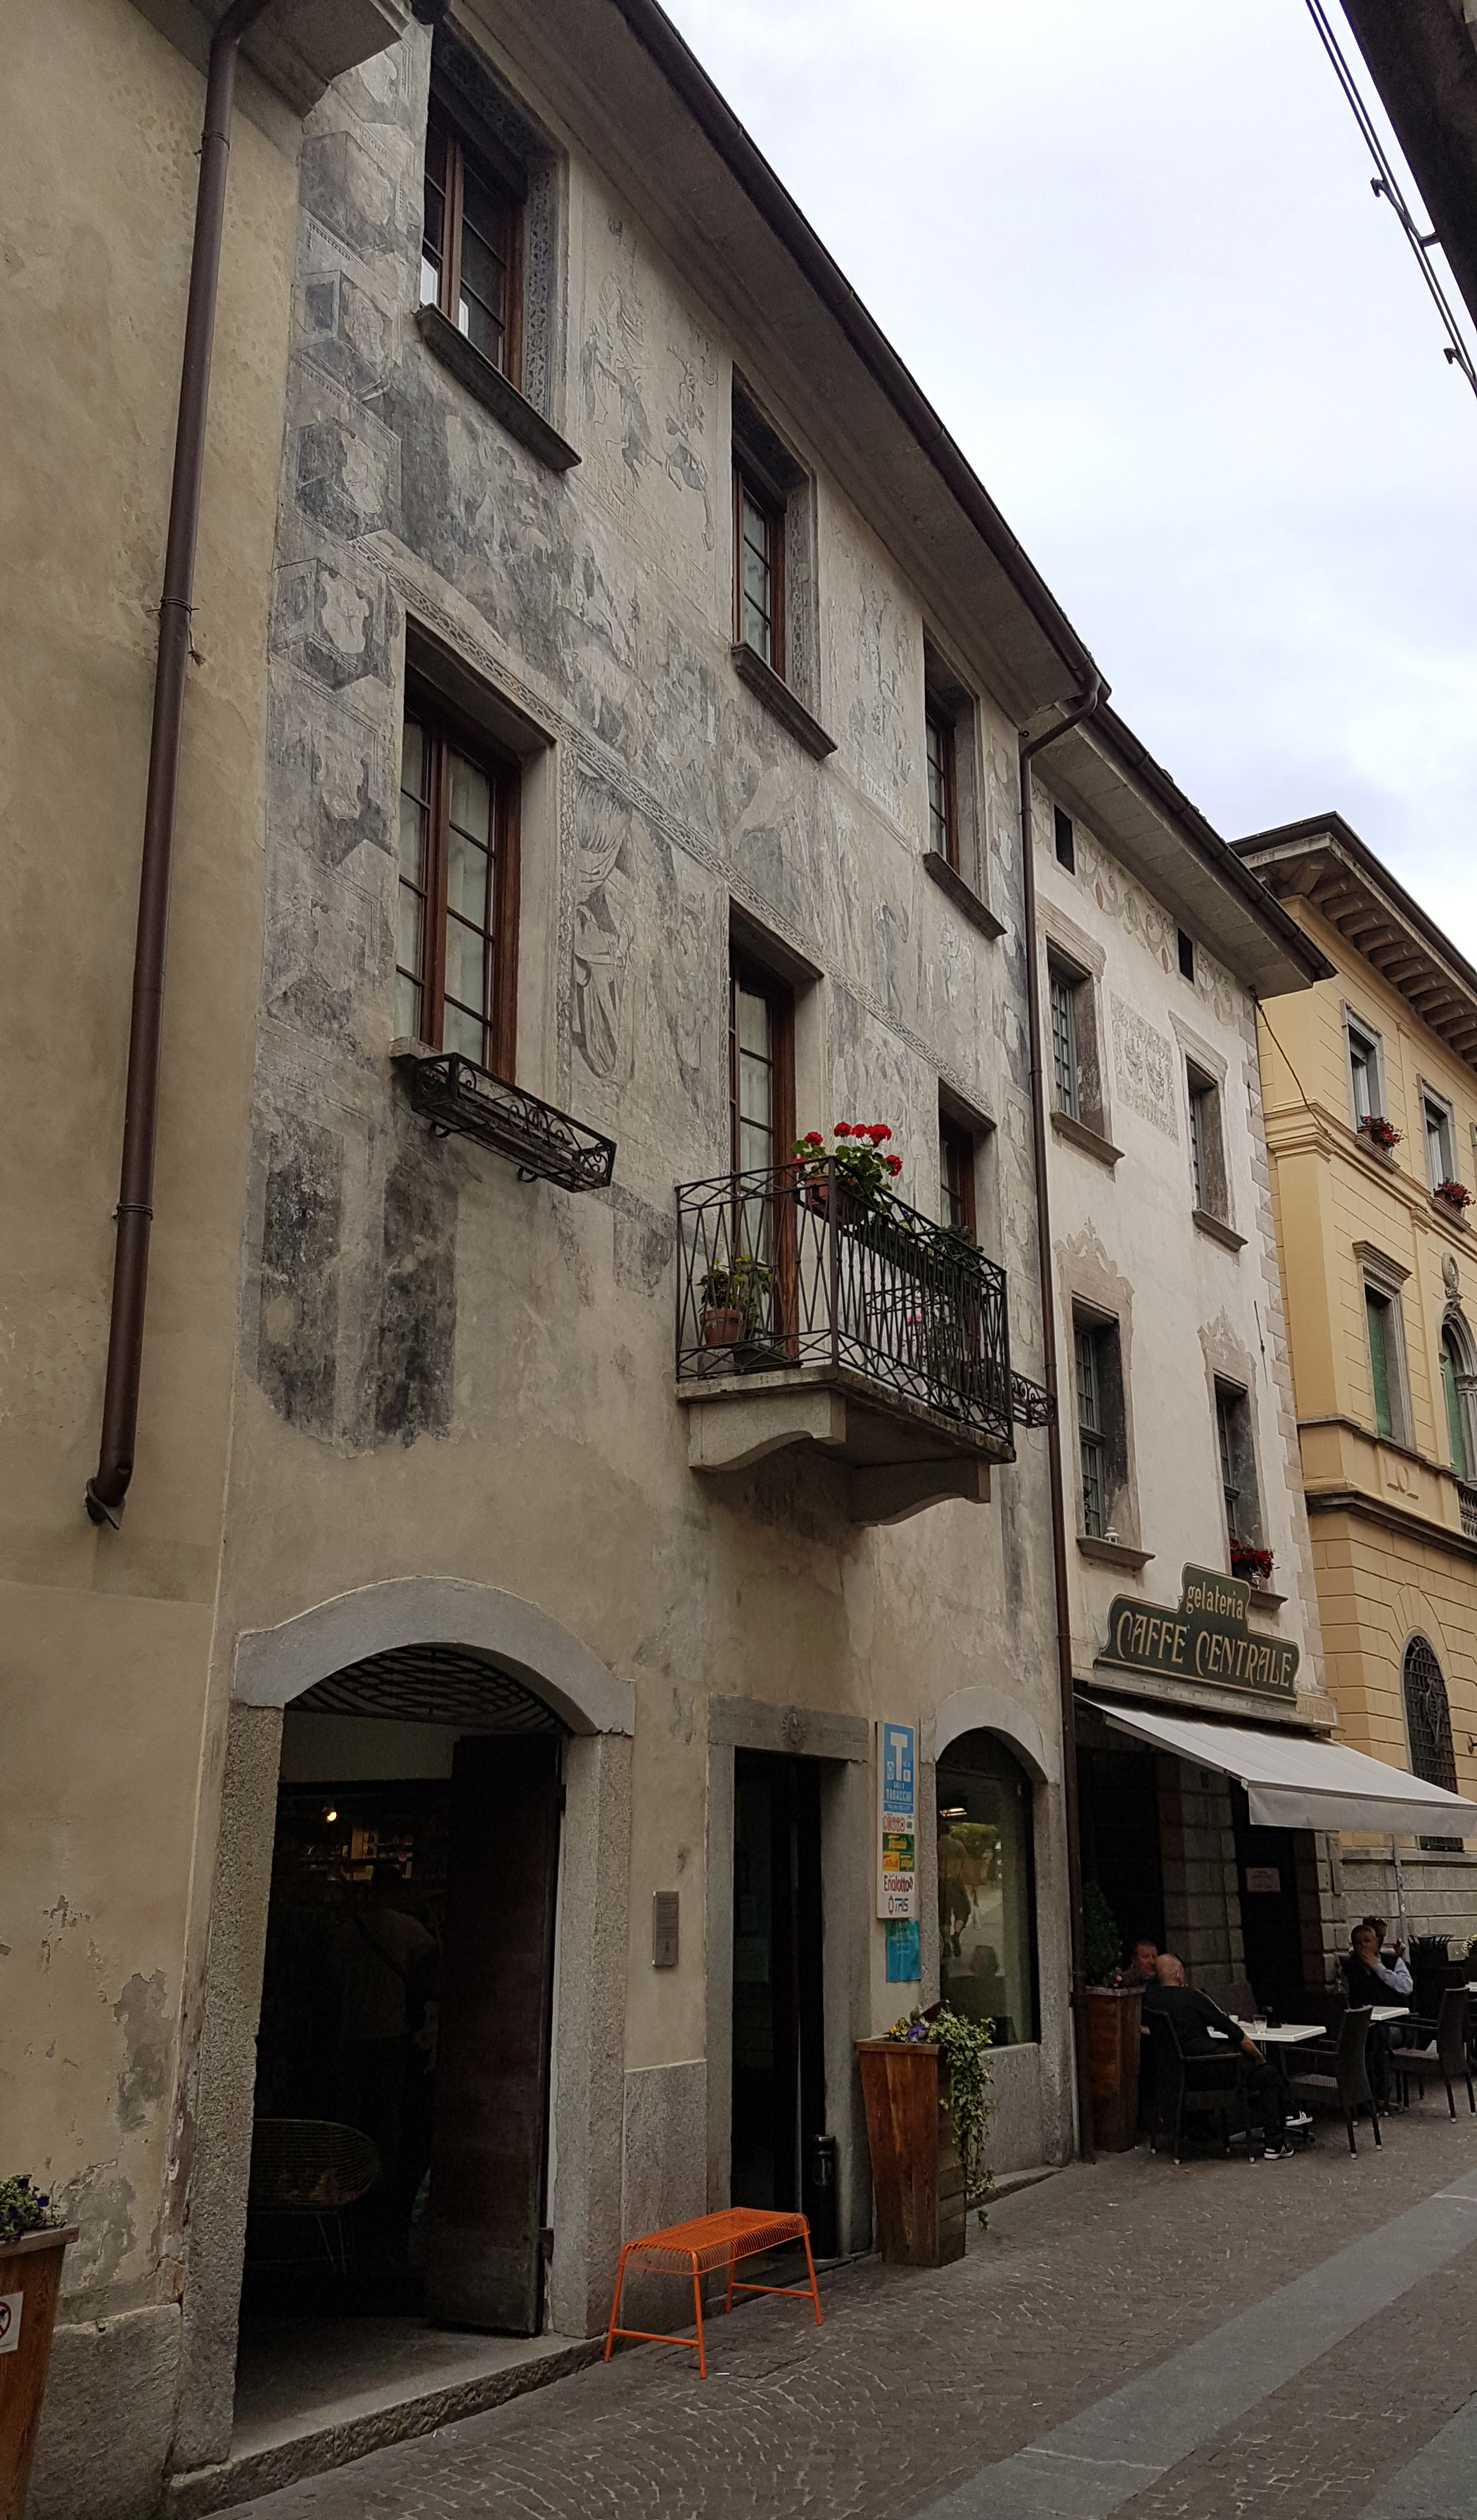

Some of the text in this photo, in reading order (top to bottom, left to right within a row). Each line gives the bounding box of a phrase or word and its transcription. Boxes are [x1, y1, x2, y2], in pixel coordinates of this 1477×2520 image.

[1186, 1582, 1243, 1619] gelateria
[1196, 1630, 1292, 1686] CENTRALE
[890, 1732, 907, 1781] T
[887, 1789, 912, 1802] TABACCHI
[884, 1874, 910, 1892] Enalotto
[895, 1898, 909, 1912] TRIS
